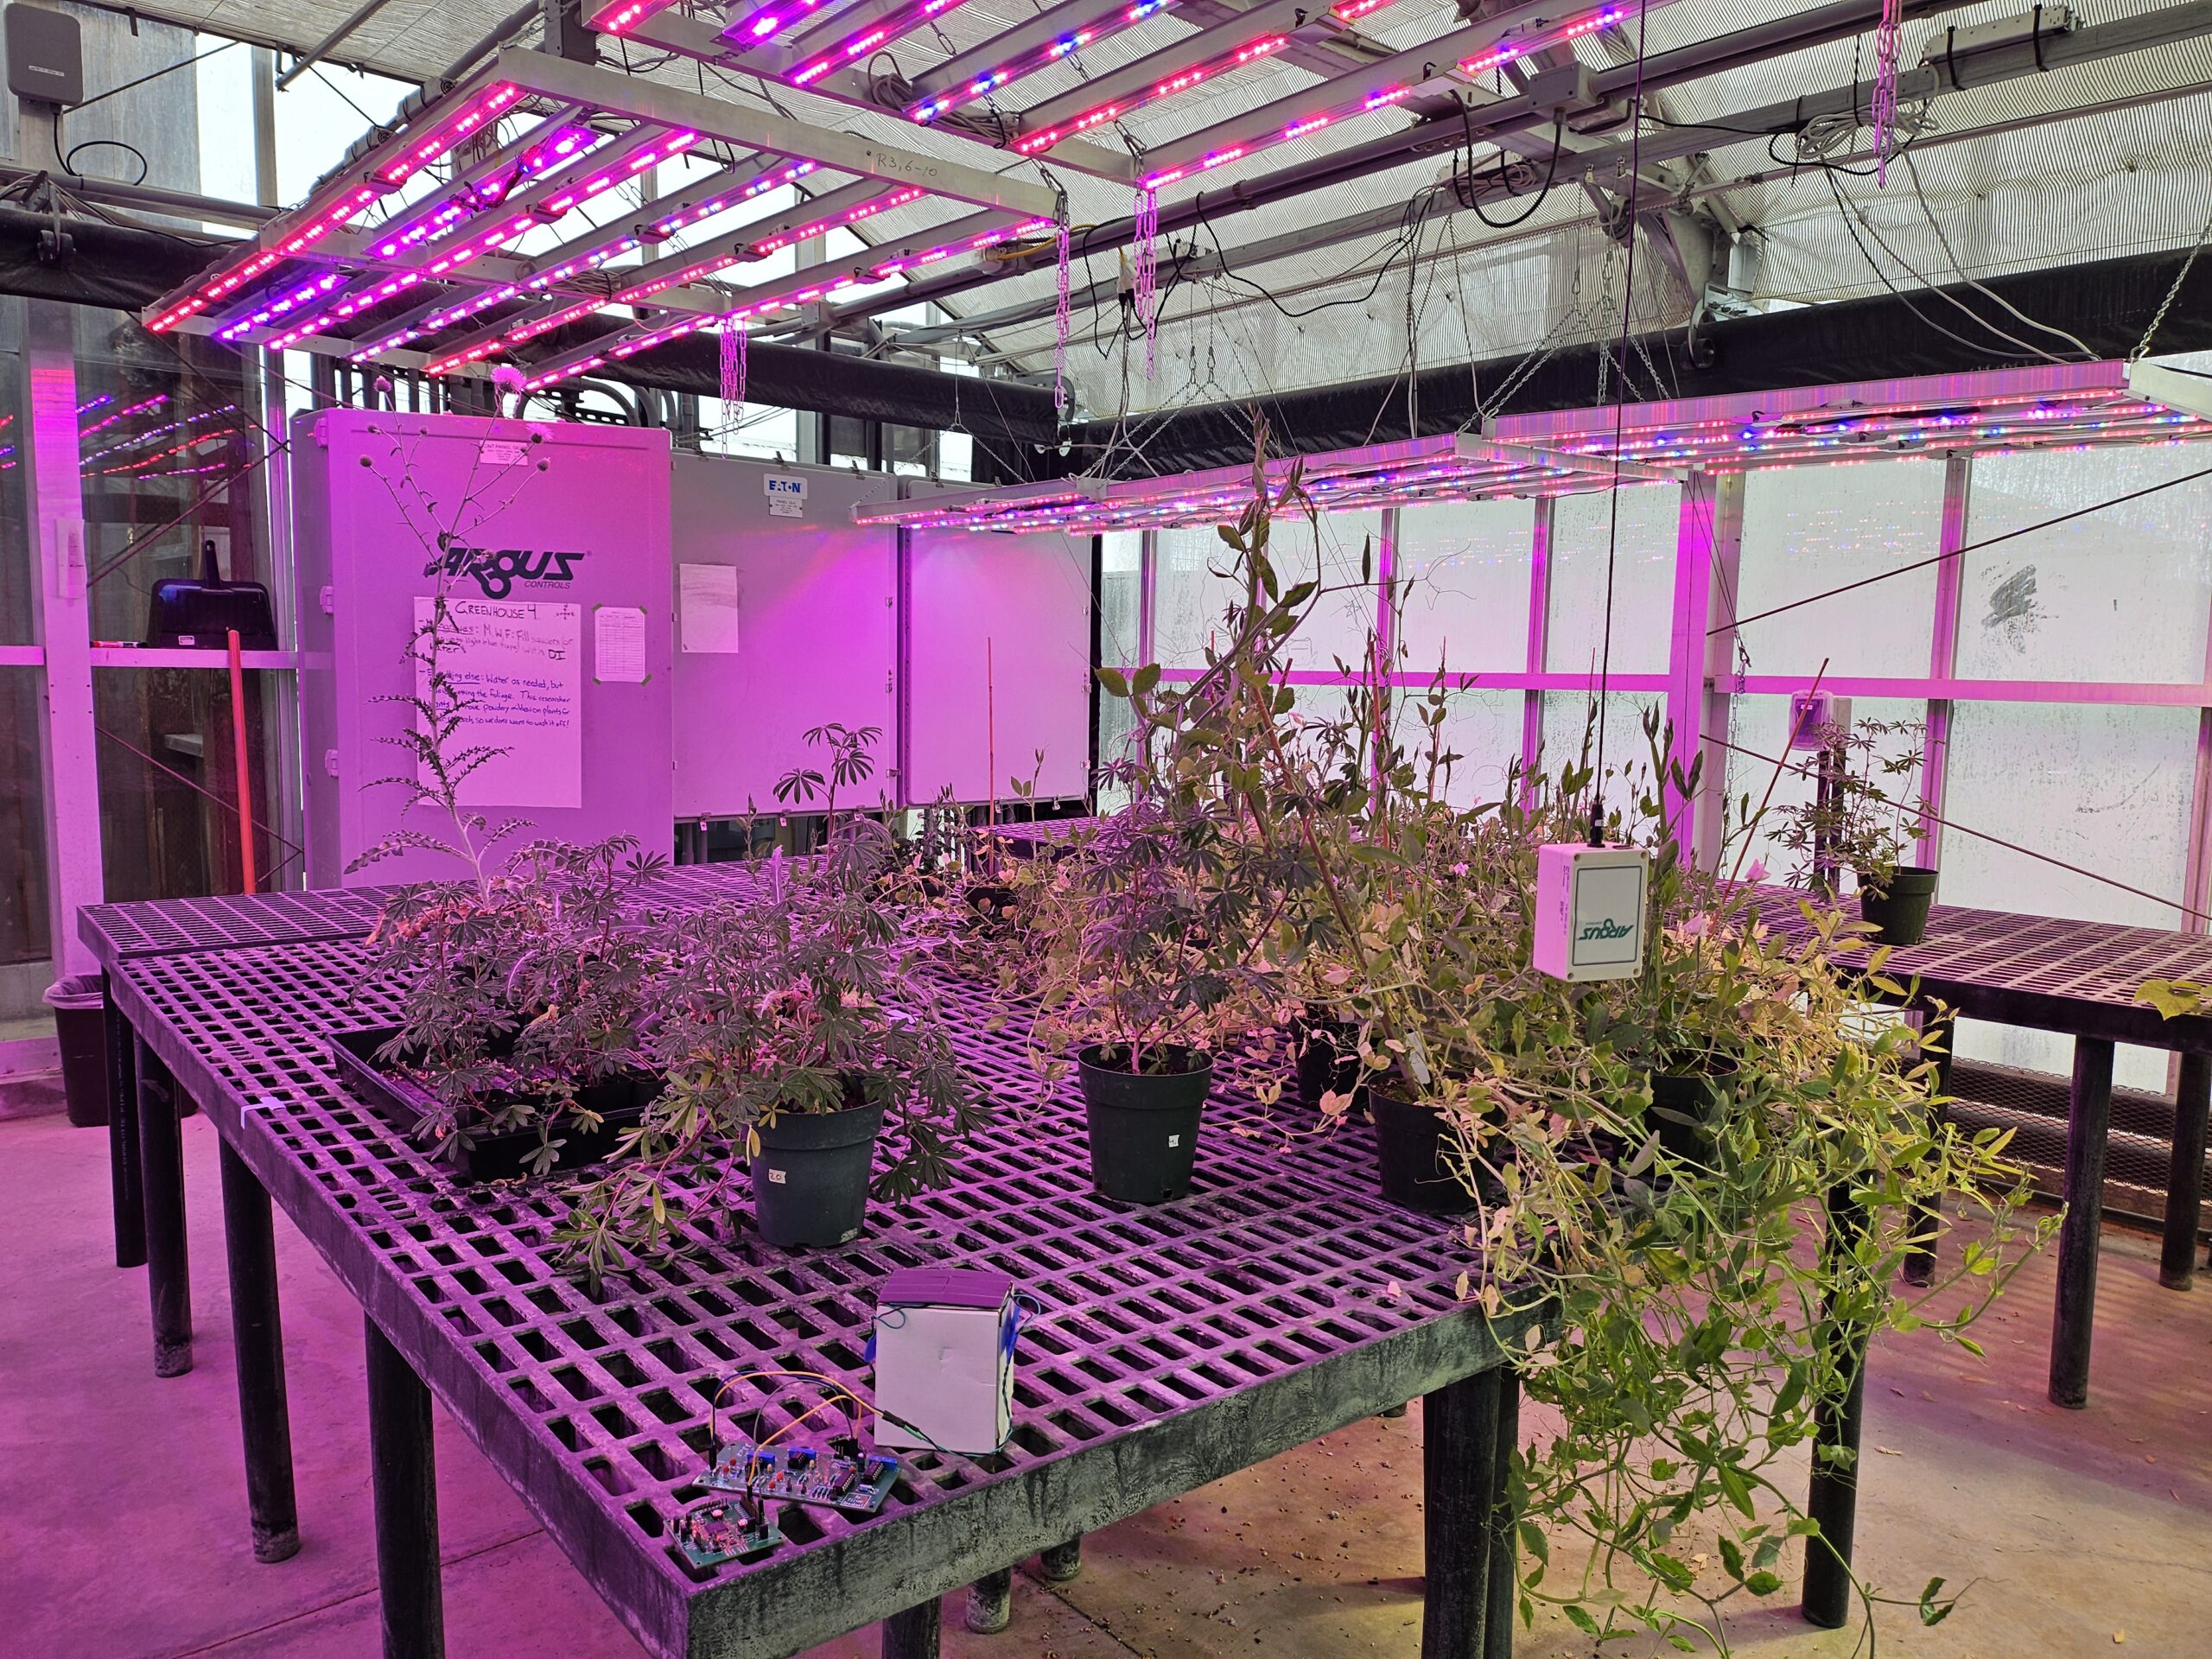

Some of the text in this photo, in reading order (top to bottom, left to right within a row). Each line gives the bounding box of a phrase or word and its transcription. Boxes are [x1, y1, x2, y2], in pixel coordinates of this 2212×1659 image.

[769, 480, 802, 493] EATON
[524, 580, 571, 588] CONTROLS
[454, 601, 537, 620] GREENHOUSE 4
[548, 649, 566, 660] DI
[486, 673, 509, 683] Water
[523, 678, 550, 690] needed,
[550, 679, 564, 689] but
[519, 690, 537, 701] This
[483, 702, 510, 714] powdery
[543, 705, 562, 716] plants
[1577, 918, 1634, 940] ARGUS
